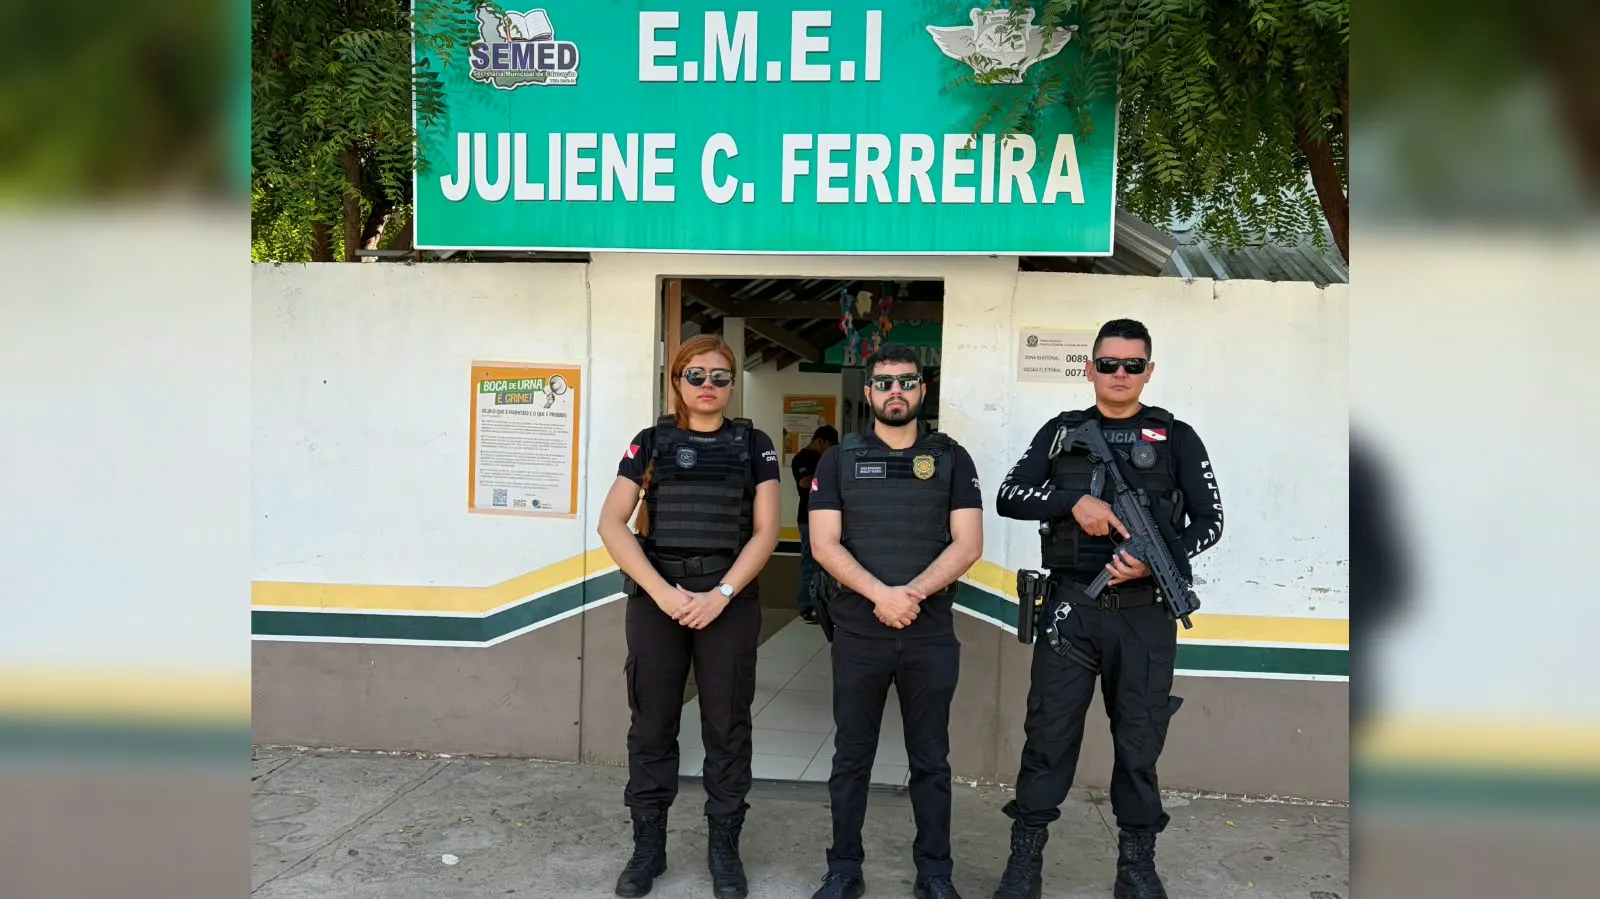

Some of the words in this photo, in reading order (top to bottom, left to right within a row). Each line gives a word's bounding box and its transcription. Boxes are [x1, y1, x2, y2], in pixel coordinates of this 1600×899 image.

[638, 10, 882, 82] E.M.E.I
[471, 42, 577, 70] SEMED
[440, 132, 676, 203] JULIENE
[701, 132, 755, 204] C.
[781, 133, 1085, 204] FERREIRA
[1065, 354, 1088, 362] 0089
[1065, 368, 1087, 377] 0071
[483, 380, 507, 391] BOCA
[508, 382, 517, 390] DE
[517, 379, 543, 390] URNA
[497, 393, 503, 404] É
[505, 393, 532, 404] CRIME!
